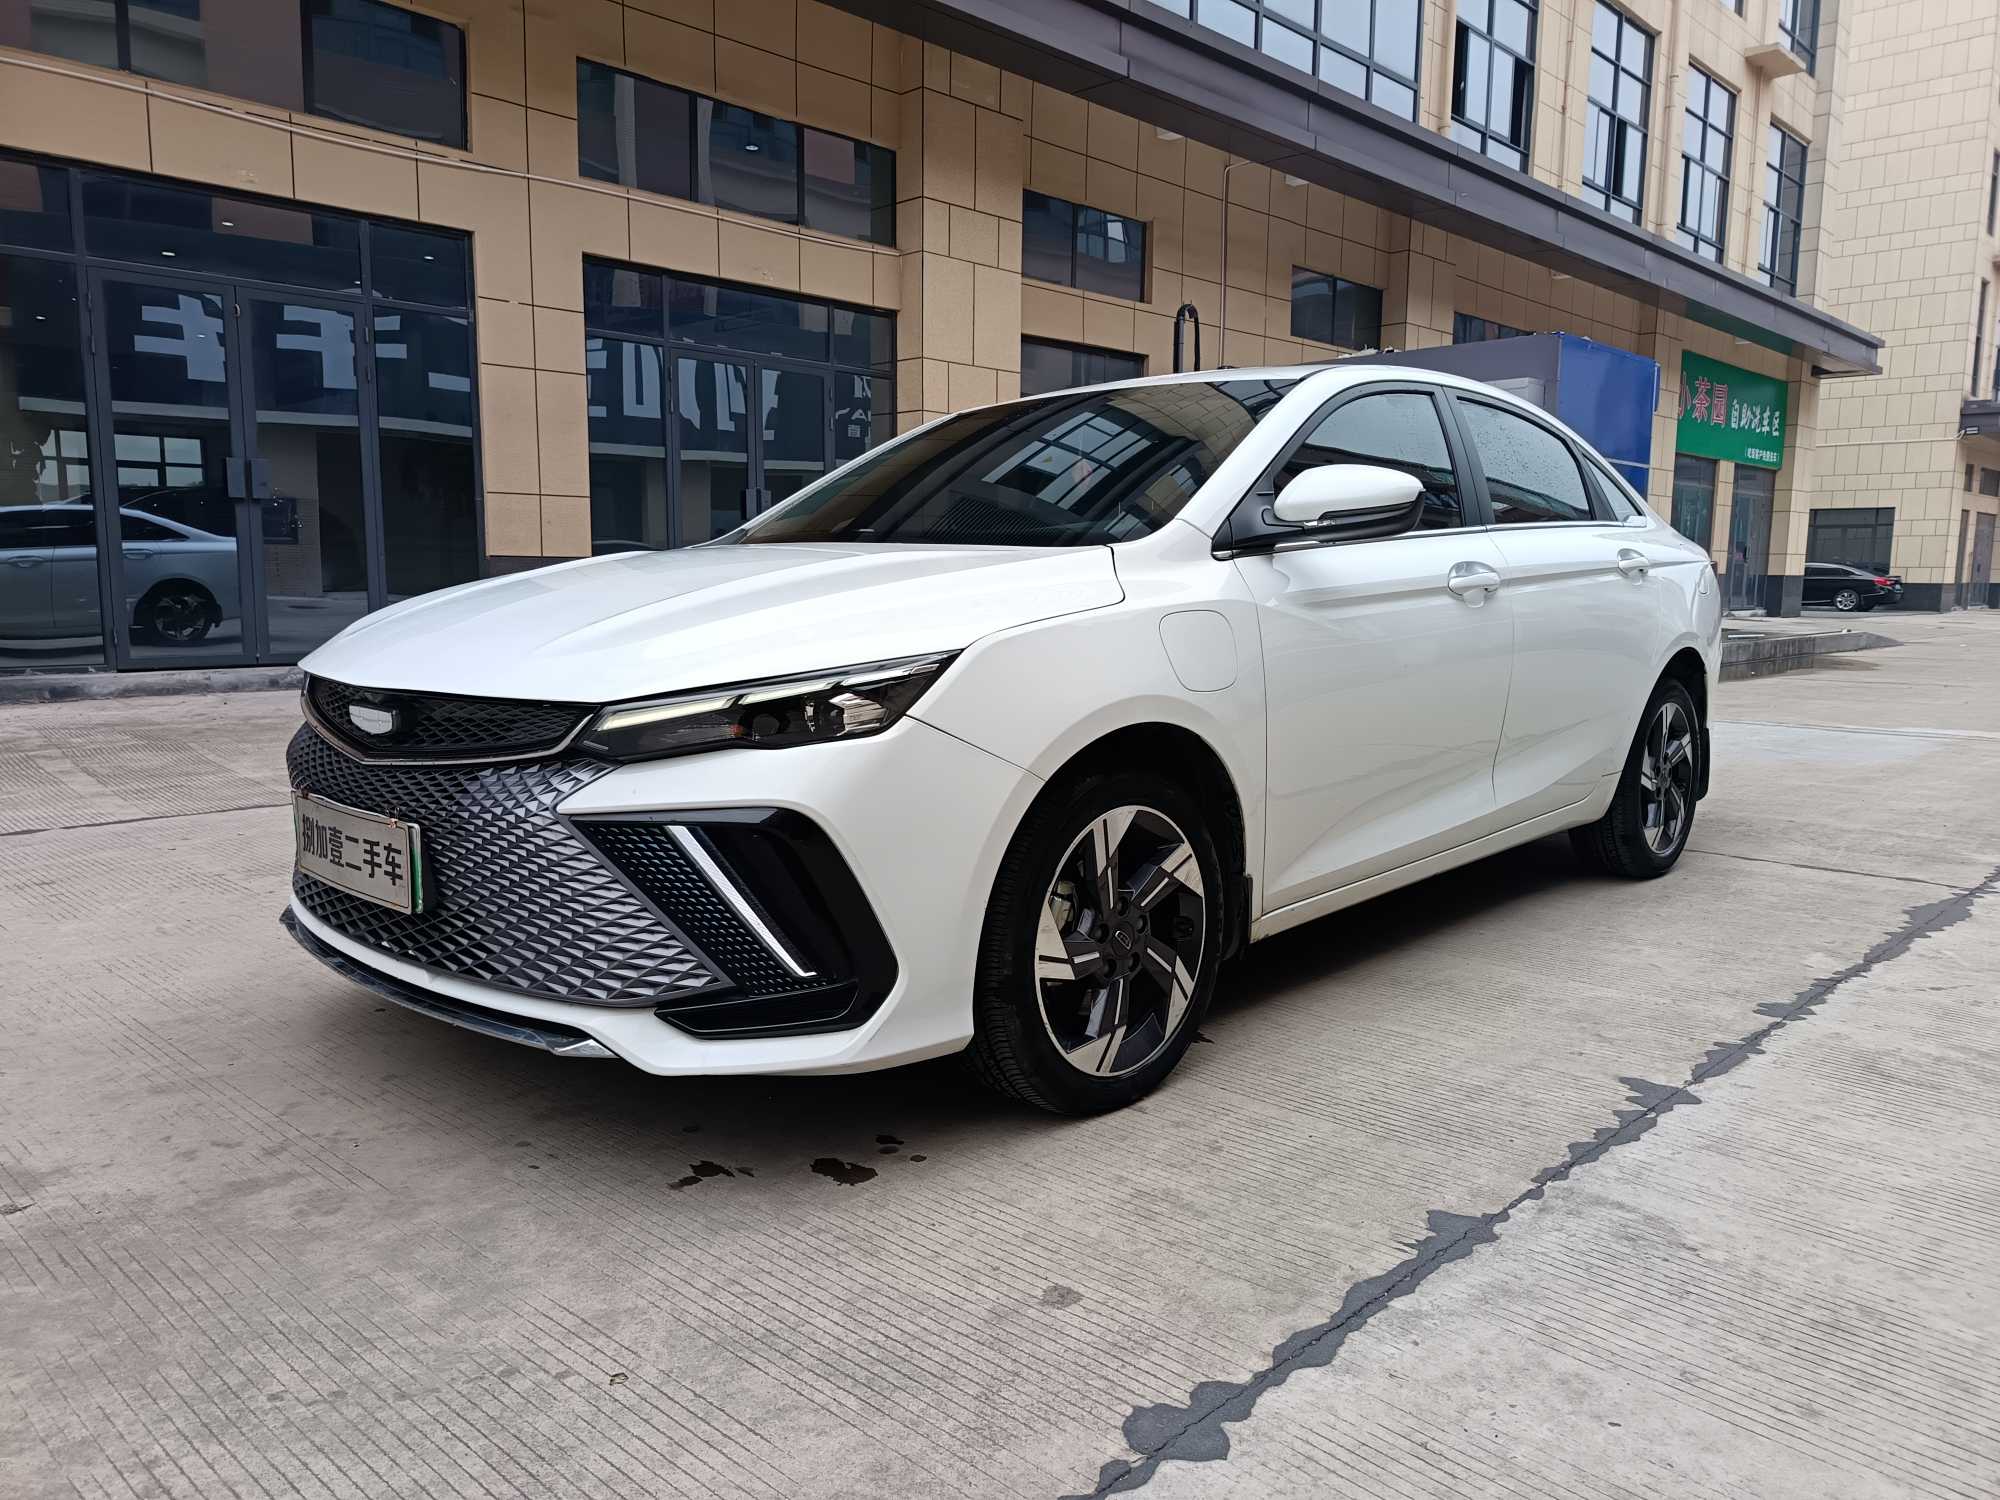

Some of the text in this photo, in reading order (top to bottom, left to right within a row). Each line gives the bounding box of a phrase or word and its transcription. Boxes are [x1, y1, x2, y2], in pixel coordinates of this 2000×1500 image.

[1731, 399, 1780, 437] 自助洗车区
[302, 814, 404, 886] 捌加壹二手车
